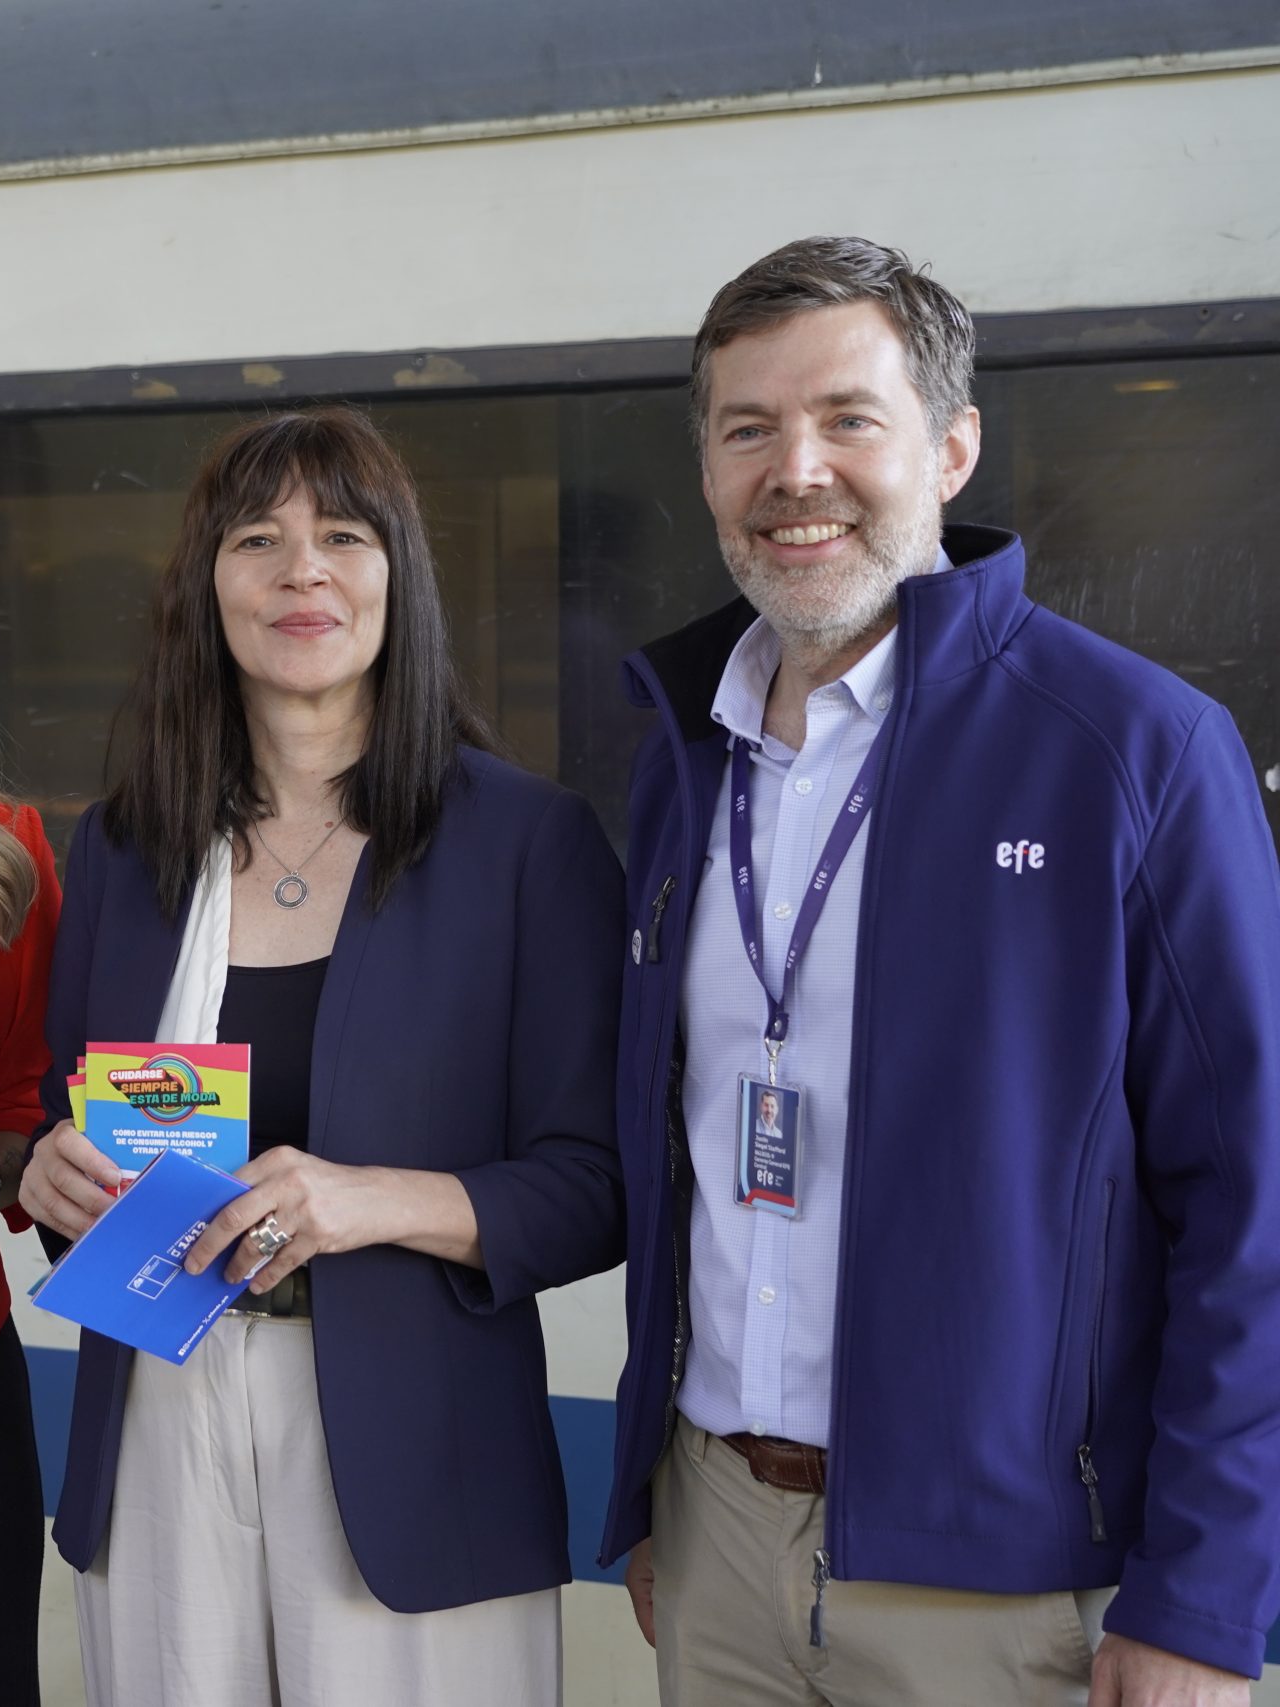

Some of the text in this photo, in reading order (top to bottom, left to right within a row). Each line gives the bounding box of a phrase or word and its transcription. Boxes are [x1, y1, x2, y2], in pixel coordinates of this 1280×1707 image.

[996, 840, 1045, 874] efe
[110, 1070, 164, 1080] CUIDARSE
[121, 1081, 178, 1093] SIEMPRE
[162, 1094, 178, 1102] DE
[180, 1092, 216, 1102] MODA
[137, 1130, 165, 1138] EVITAR
[182, 1131, 217, 1139] RIESGOS
[128, 1138, 168, 1146] CONSUMIR
[170, 1140, 206, 1148] ALCOHOL
[757, 1170, 774, 1186] efe
[178, 1221, 207, 1250] 1412
